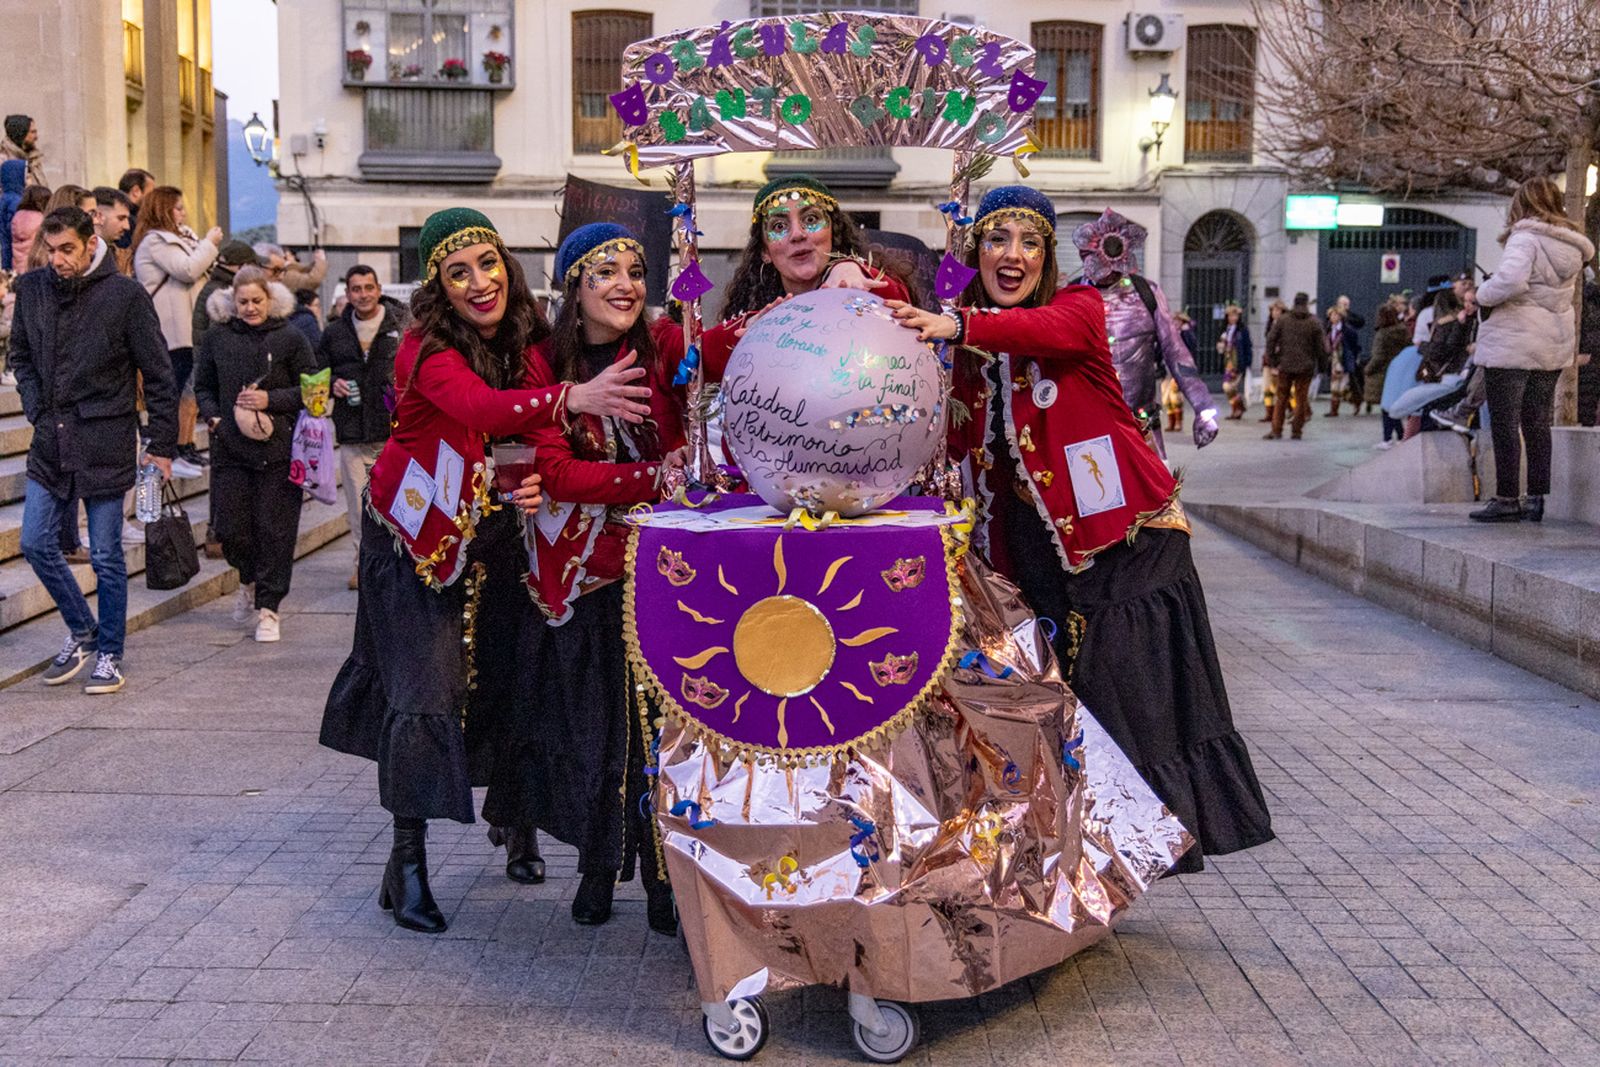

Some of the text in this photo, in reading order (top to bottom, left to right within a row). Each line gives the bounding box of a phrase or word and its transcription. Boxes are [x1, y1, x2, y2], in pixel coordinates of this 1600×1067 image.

[658, 87, 812, 142] SANTO
[730, 374, 809, 428] Catedral
[876, 373, 919, 404] final
[743, 410, 865, 457] Patrimonio
[774, 447, 903, 475] Humanidad
